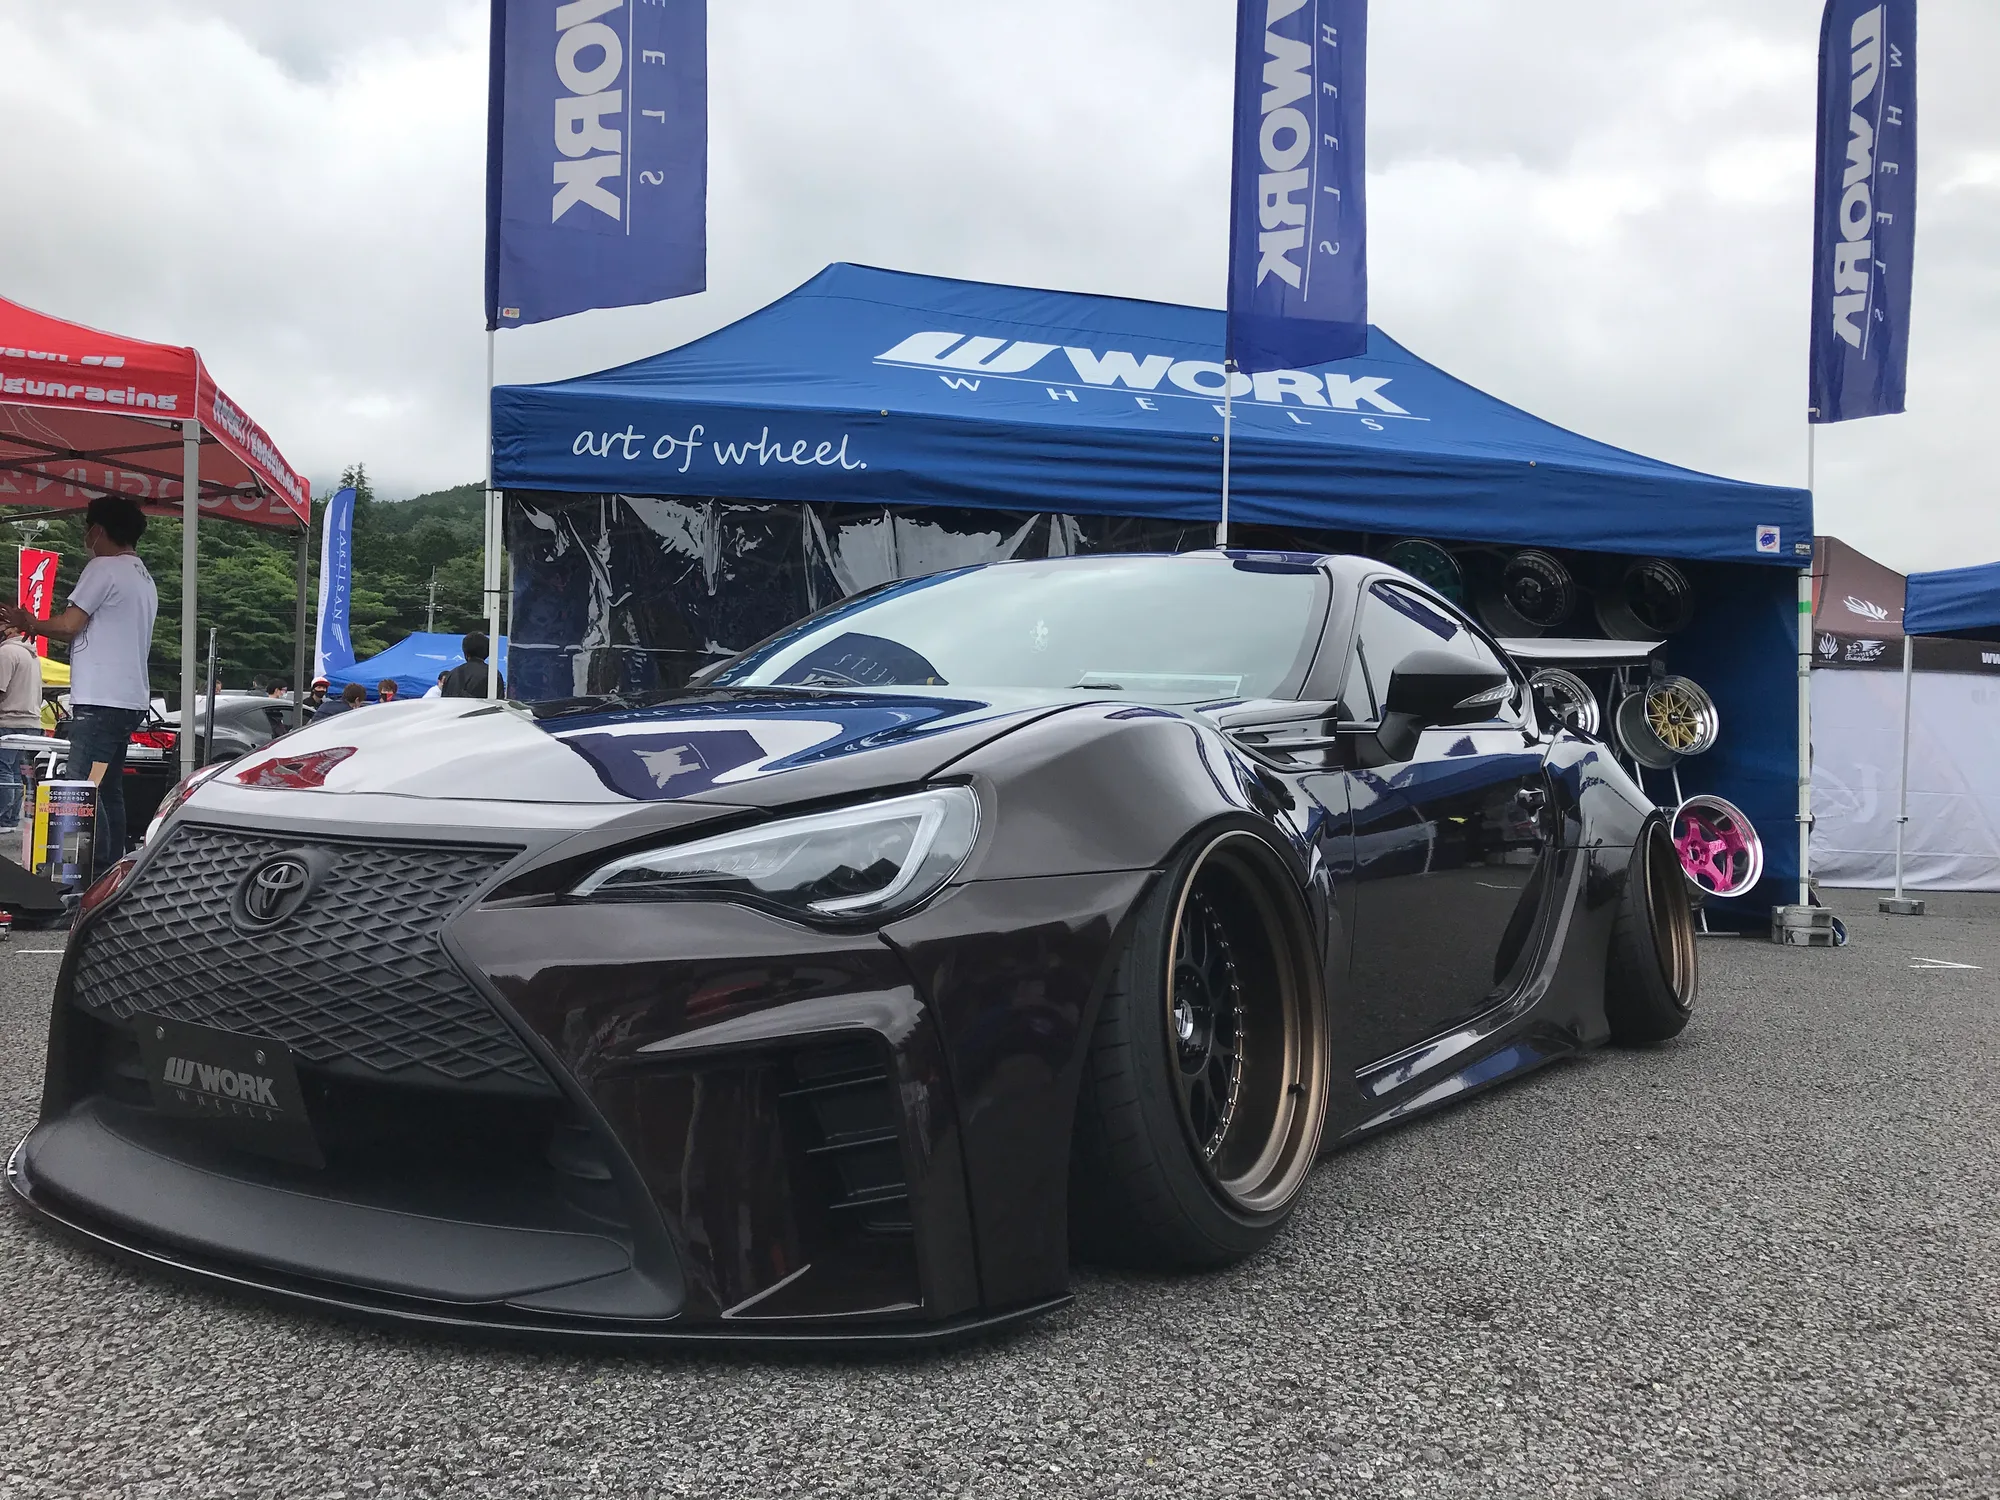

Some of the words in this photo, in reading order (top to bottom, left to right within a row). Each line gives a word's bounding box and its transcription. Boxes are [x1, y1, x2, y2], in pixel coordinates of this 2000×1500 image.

[1062, 345, 1412, 415] WORK
[572, 424, 646, 461] art
[652, 424, 705, 473] of
[713, 426, 868, 470] wheel.
[333, 533, 347, 620] ARTISAN
[175, 1089, 273, 1122] WHEELS
[196, 1062, 278, 1107] WORK
